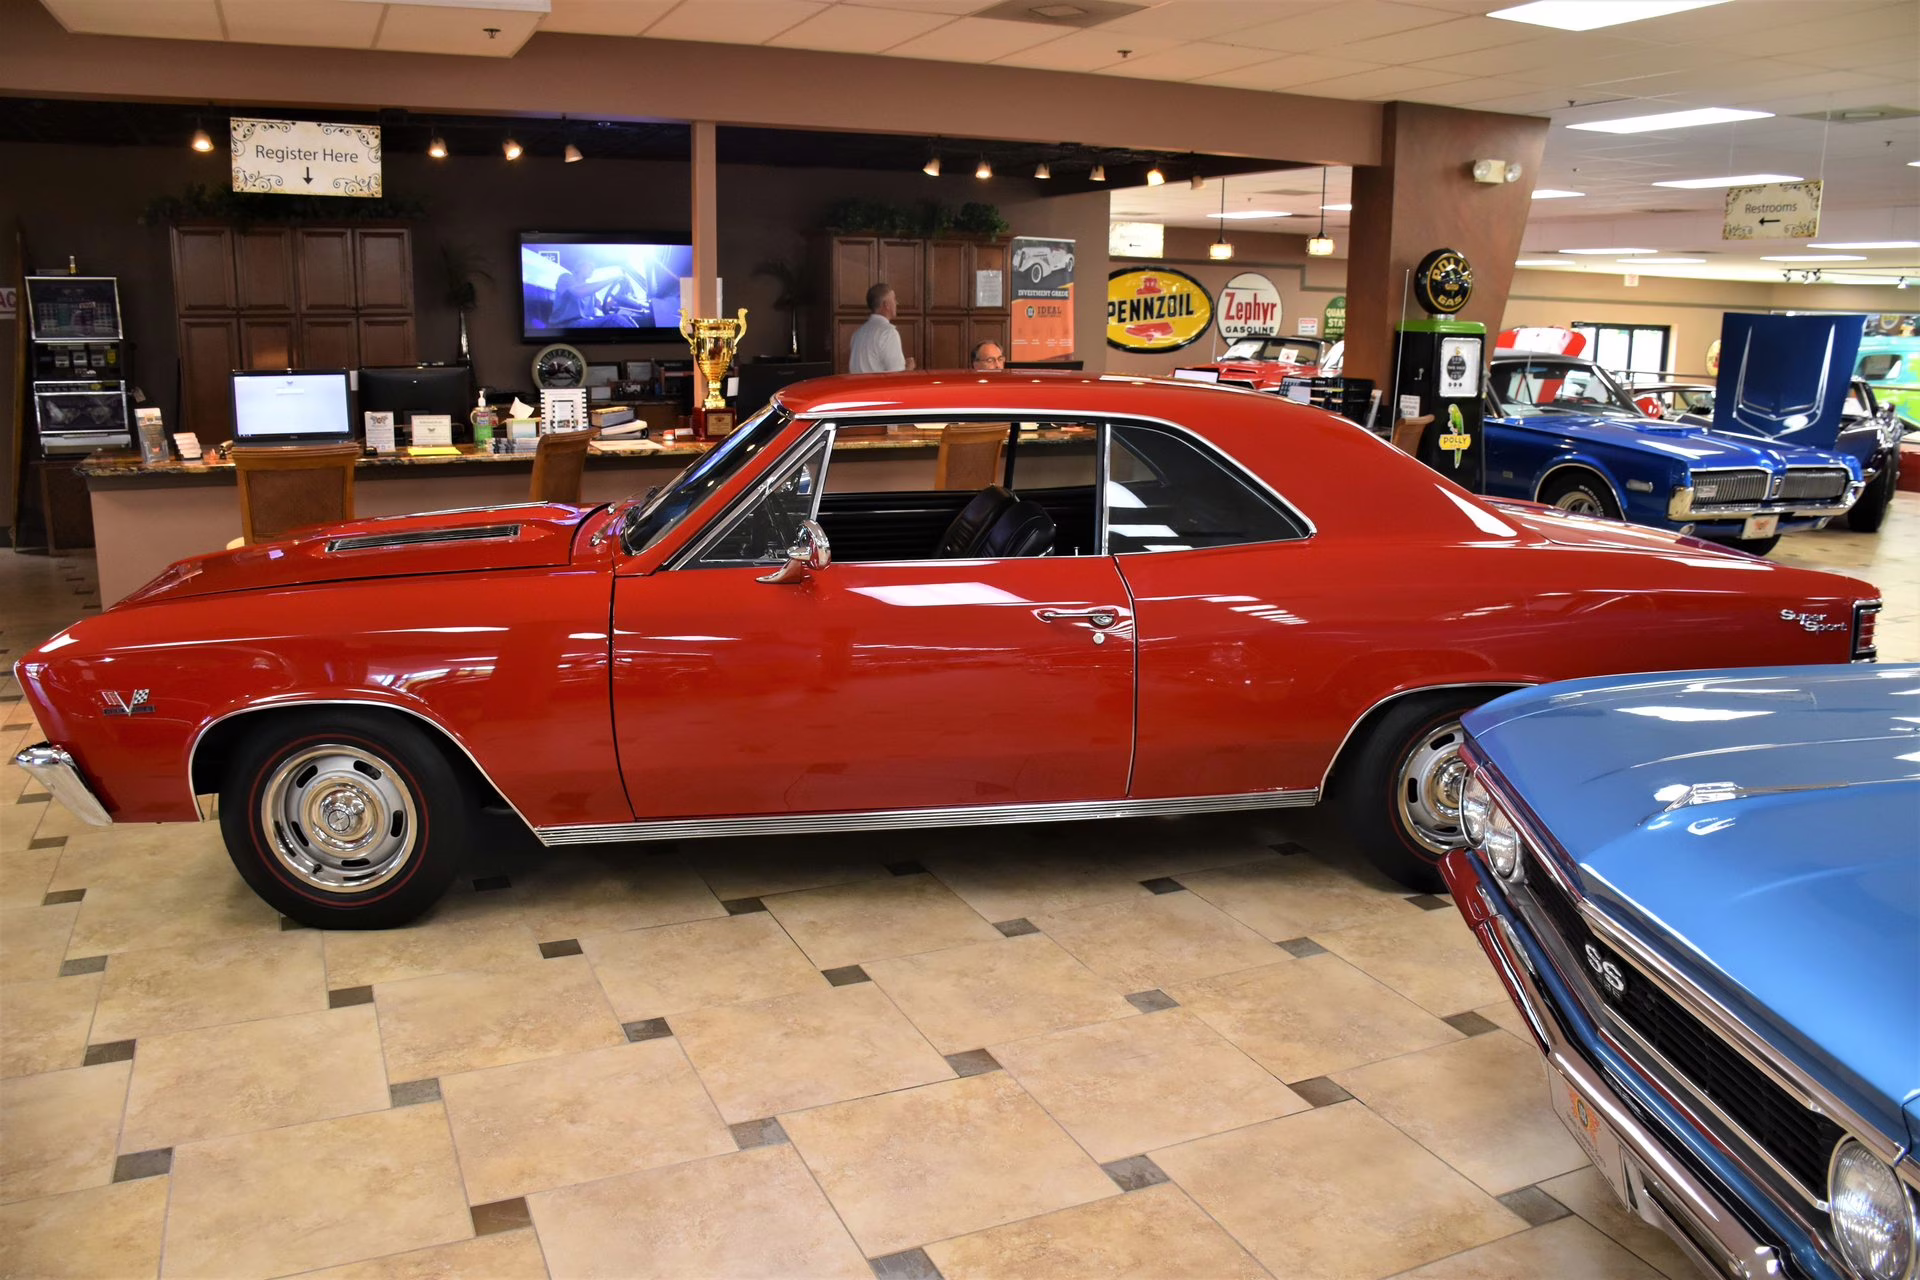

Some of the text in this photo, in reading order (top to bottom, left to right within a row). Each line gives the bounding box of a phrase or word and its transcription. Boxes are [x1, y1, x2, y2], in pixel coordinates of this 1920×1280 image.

[255, 144, 359, 163] Register Here
[1744, 203, 1798, 214] Restrooms
[1017, 289, 1051, 297] INVESTMENT
[1438, 294, 1463, 306] GAS
[1037, 306, 1062, 314] IDEAL
[1108, 293, 1194, 323] PENNZOIL
[1224, 292, 1277, 325] Zephyr
[1225, 326, 1275, 334] GASOLINE
[1443, 436, 1468, 445] POLLY
[1780, 609, 1828, 625] Super
[1804, 621, 1848, 635] Sport
[1584, 944, 1625, 991] SS
